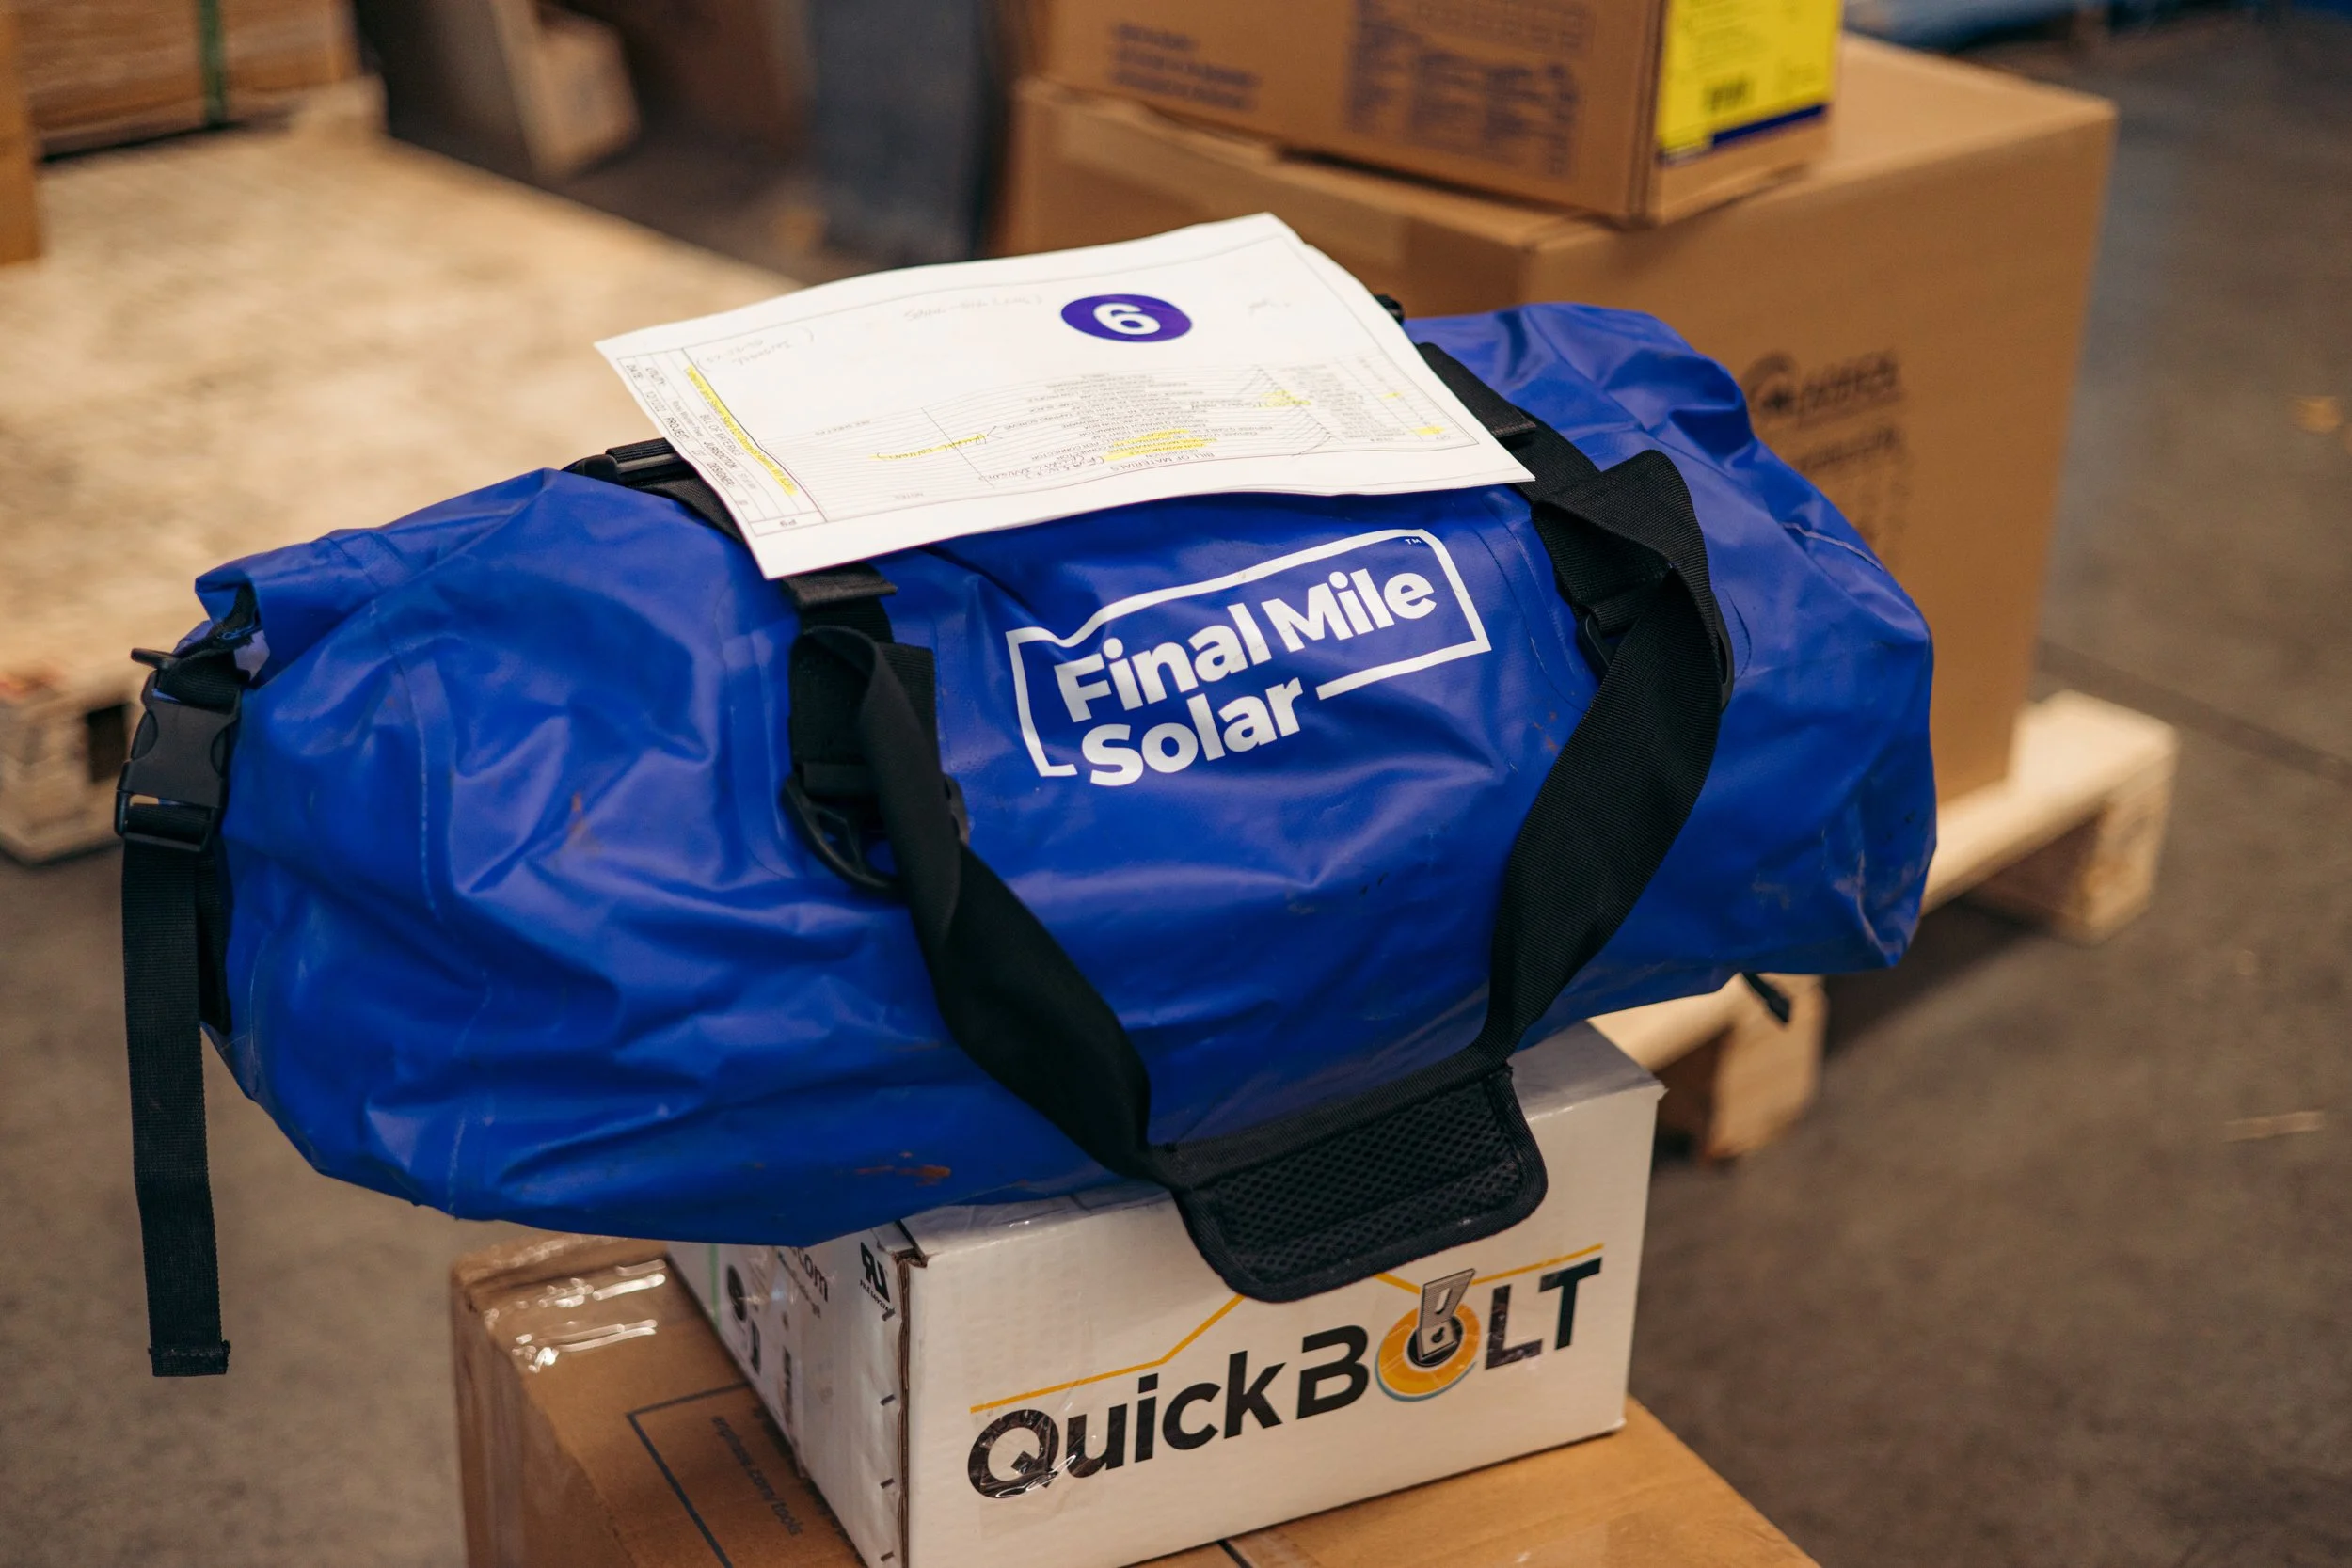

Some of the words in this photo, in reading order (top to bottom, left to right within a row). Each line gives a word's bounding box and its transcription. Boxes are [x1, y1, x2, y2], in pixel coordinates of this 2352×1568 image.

[1110, 457, 1172, 470] MATERIALS
[1054, 602, 1272, 722] Final
[1262, 568, 1437, 654] Mile
[1081, 677, 1304, 786] Solar
